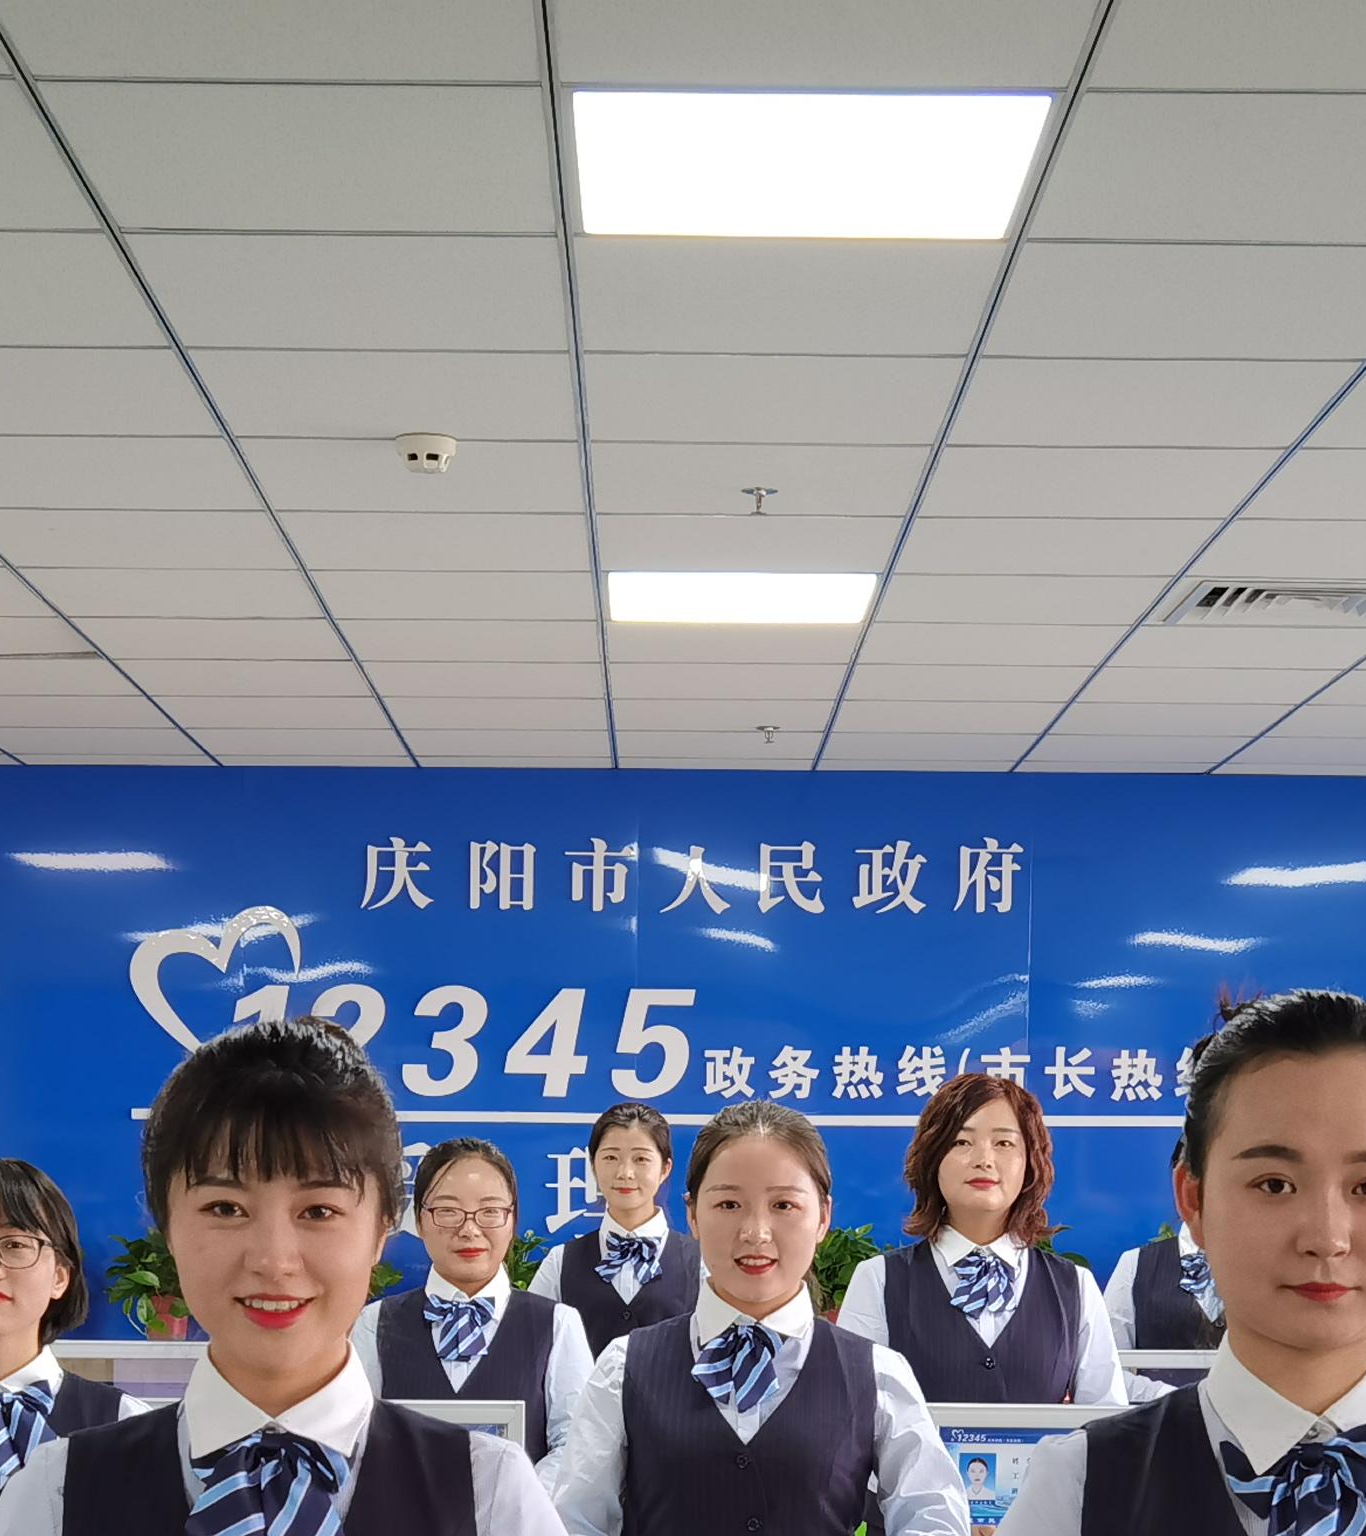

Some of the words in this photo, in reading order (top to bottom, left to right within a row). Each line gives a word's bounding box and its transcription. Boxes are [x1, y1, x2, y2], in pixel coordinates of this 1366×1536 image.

[360, 837, 1024, 914] 庆阳市人民政府
